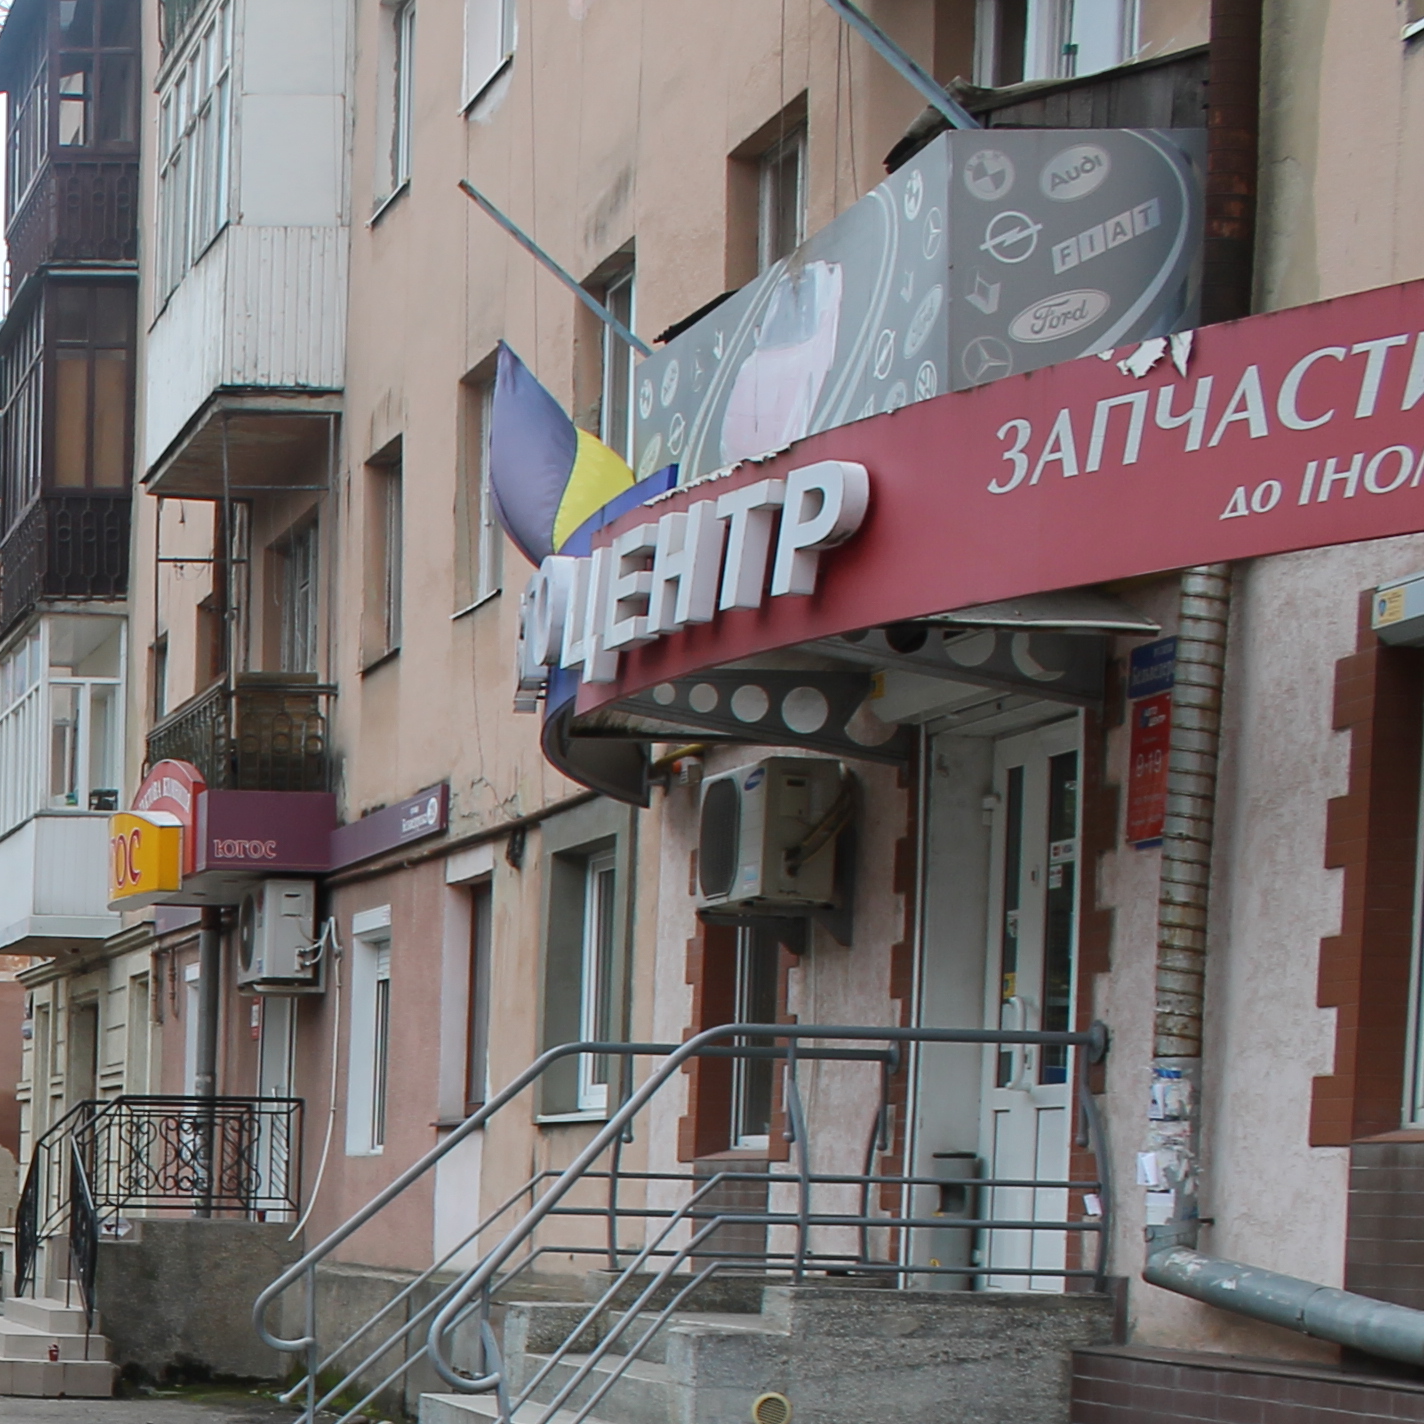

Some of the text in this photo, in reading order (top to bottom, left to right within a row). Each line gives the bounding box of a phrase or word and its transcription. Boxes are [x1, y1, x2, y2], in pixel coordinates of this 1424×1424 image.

[1050, 153, 1105, 191] Audi
[1058, 206, 1157, 269] FIAT
[1031, 298, 1090, 336] Ford
[987, 331, 1424, 494] ЗАПЧАСТ
[1298, 445, 1424, 505] ІНО
[213, 839, 277, 859] ЮГОС
